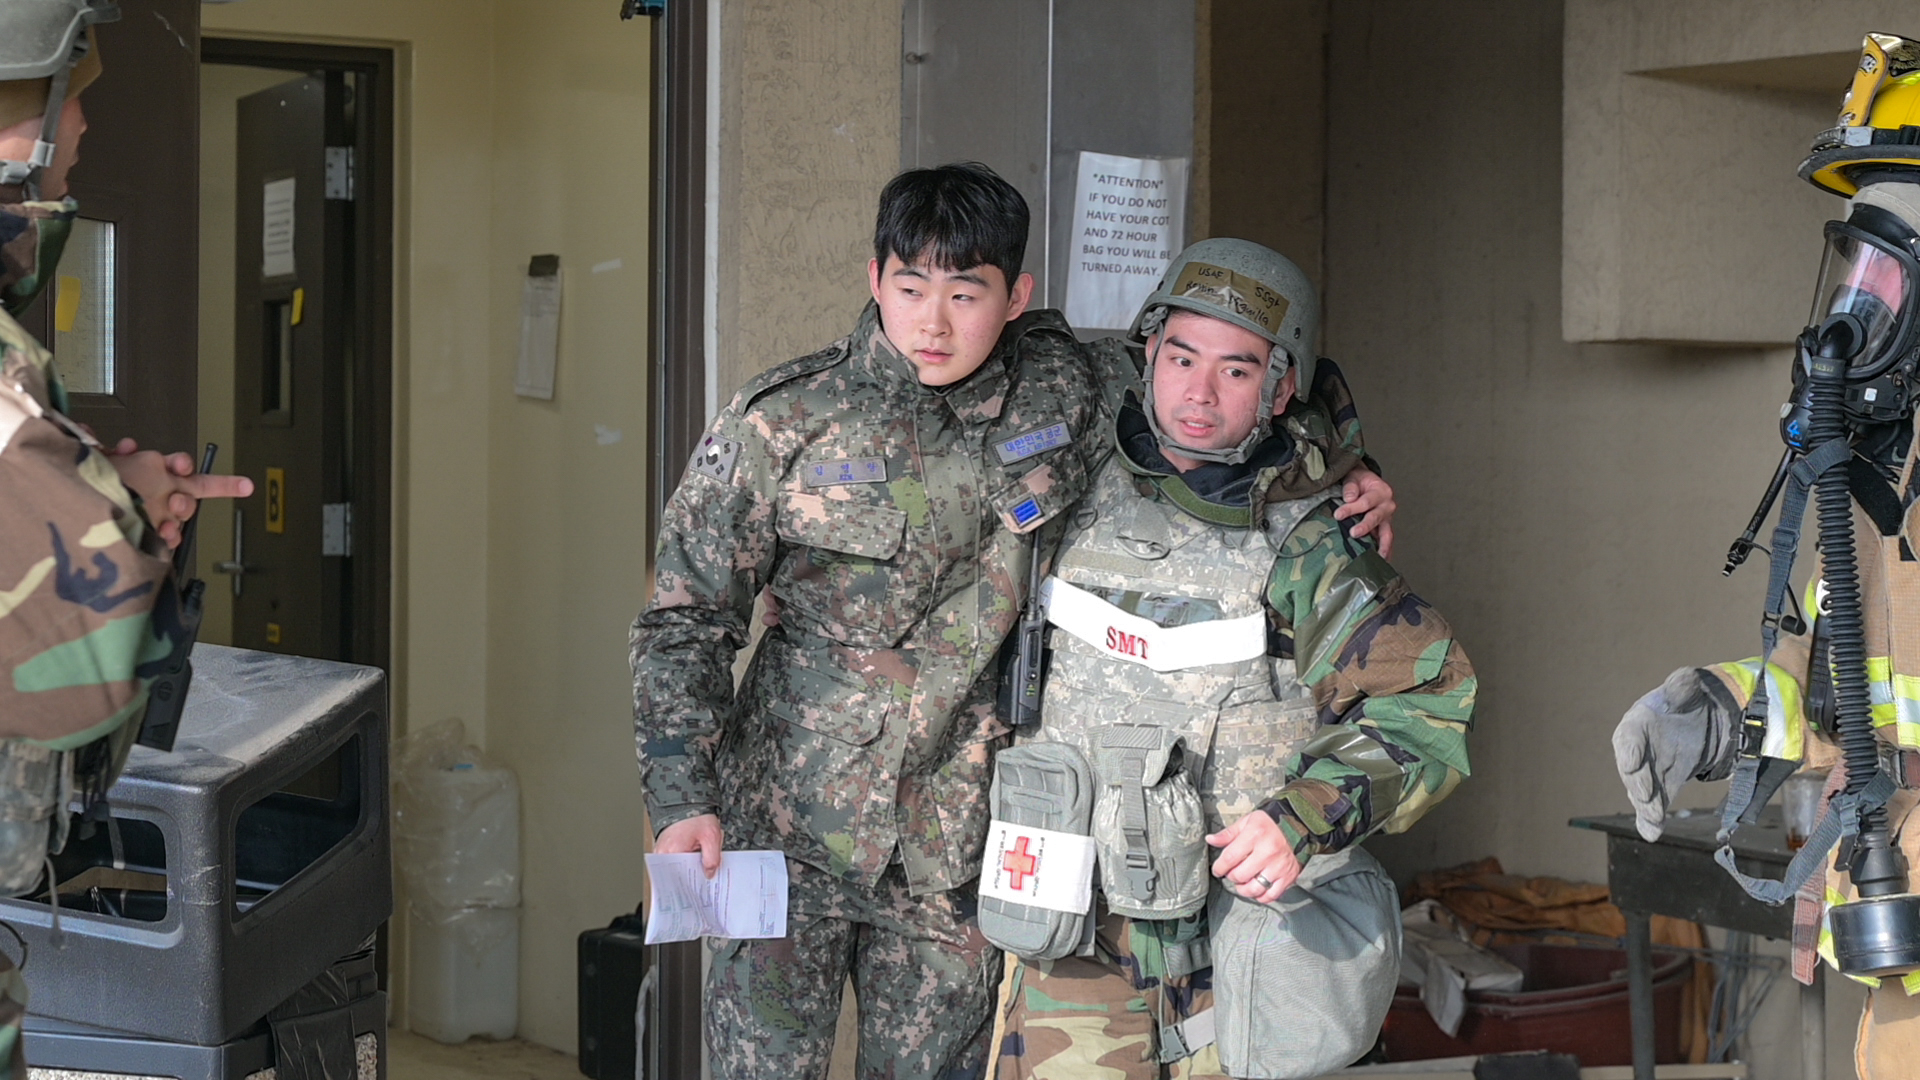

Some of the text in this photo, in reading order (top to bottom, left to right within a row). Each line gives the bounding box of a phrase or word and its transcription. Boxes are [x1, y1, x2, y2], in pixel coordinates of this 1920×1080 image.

[1088, 192, 1168, 209] IF YOU DO NOT
[1086, 210, 1170, 226] HAVE YOUR COT
[1084, 227, 1158, 243] AND 72 HOUR
[1083, 244, 1171, 260] BAG YOU WILL BE
[1081, 261, 1161, 277] TURNED AWAY.
[1198, 267, 1224, 279] USAF
[1254, 286, 1281, 309] SSgt
[1004, 425, 1063, 452] 대한민국 공군
[1106, 625, 1149, 660] SMT
